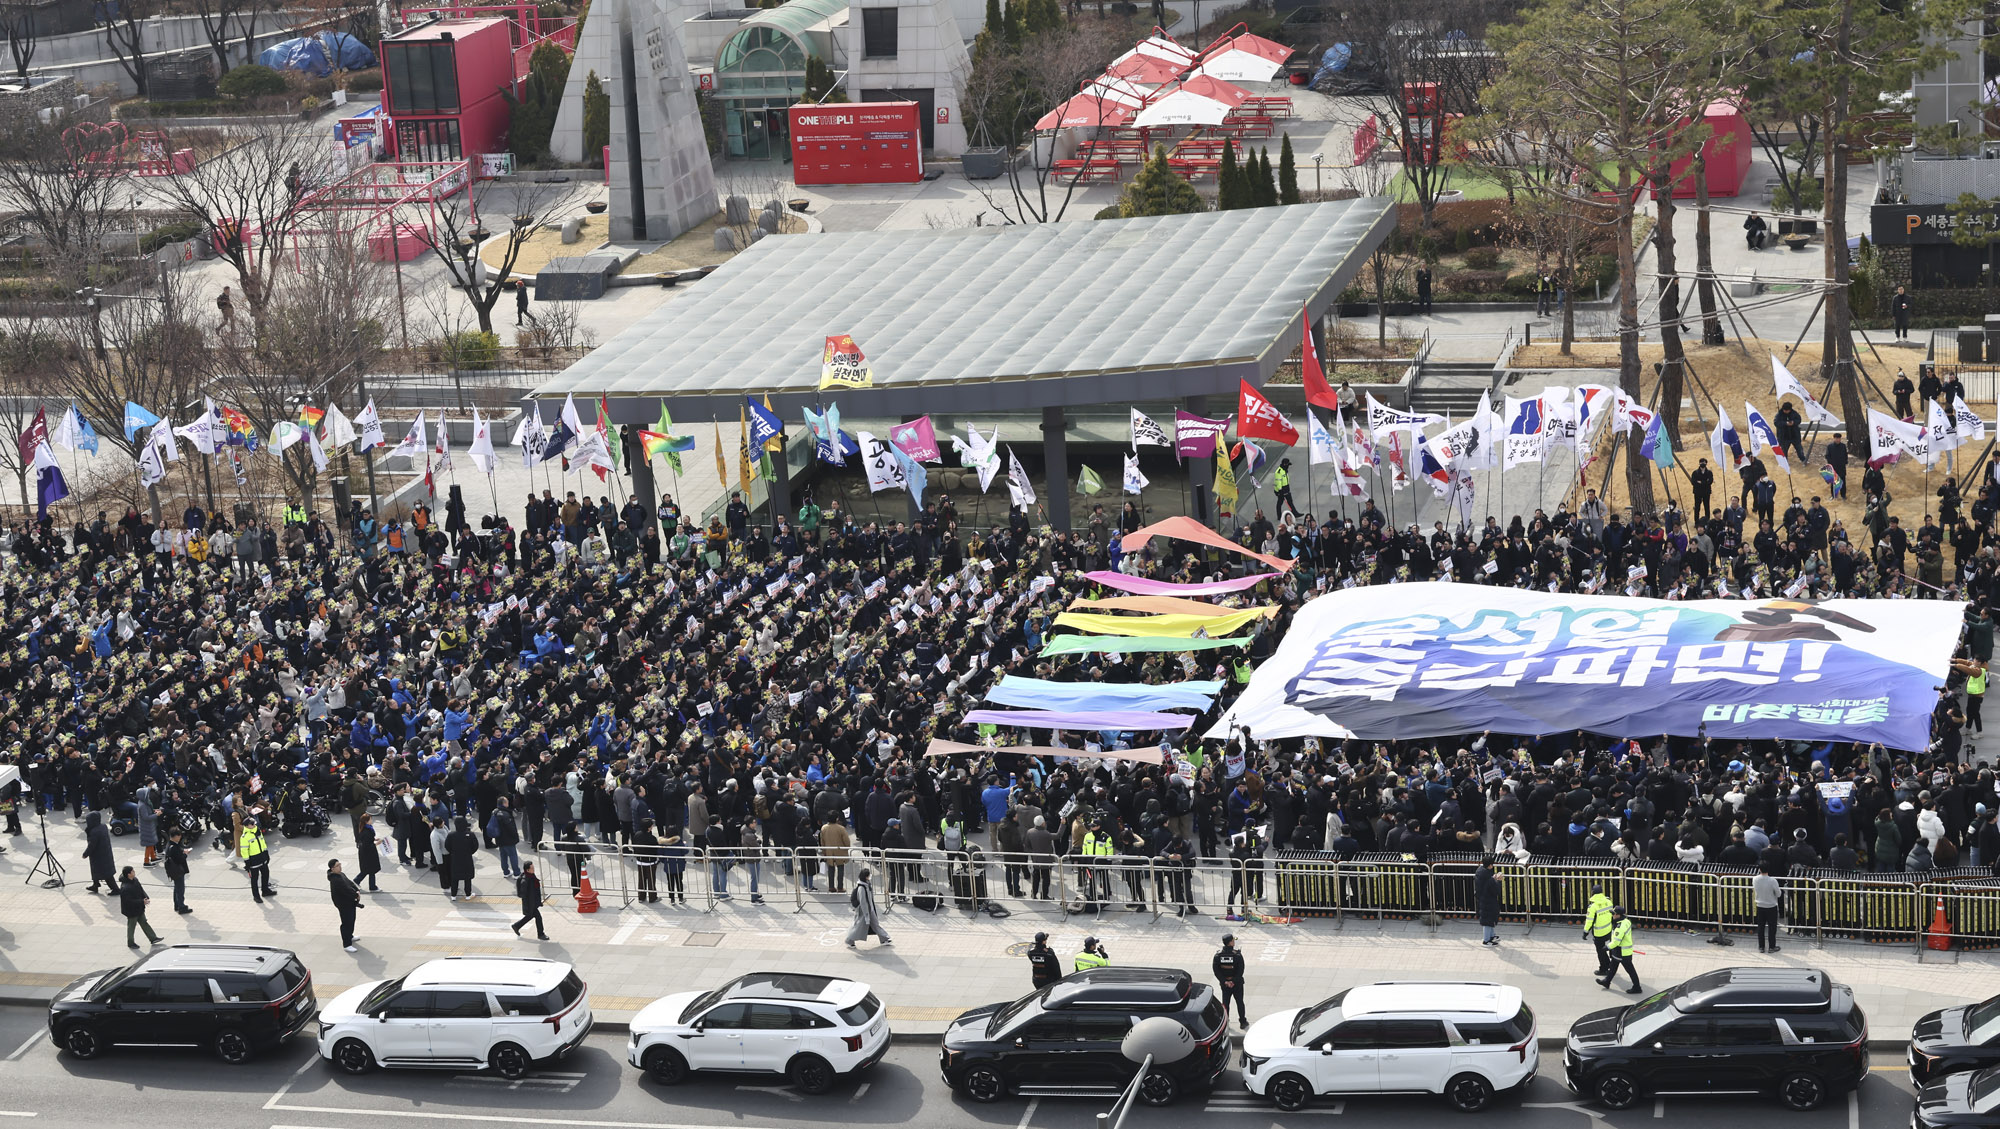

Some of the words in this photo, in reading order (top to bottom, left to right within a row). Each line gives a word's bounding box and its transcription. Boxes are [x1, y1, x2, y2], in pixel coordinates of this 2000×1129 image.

[1906, 214, 1922, 235] P
[1323, 607, 1681, 661] 윤석열
[1702, 703, 1889, 725] 비상행동
